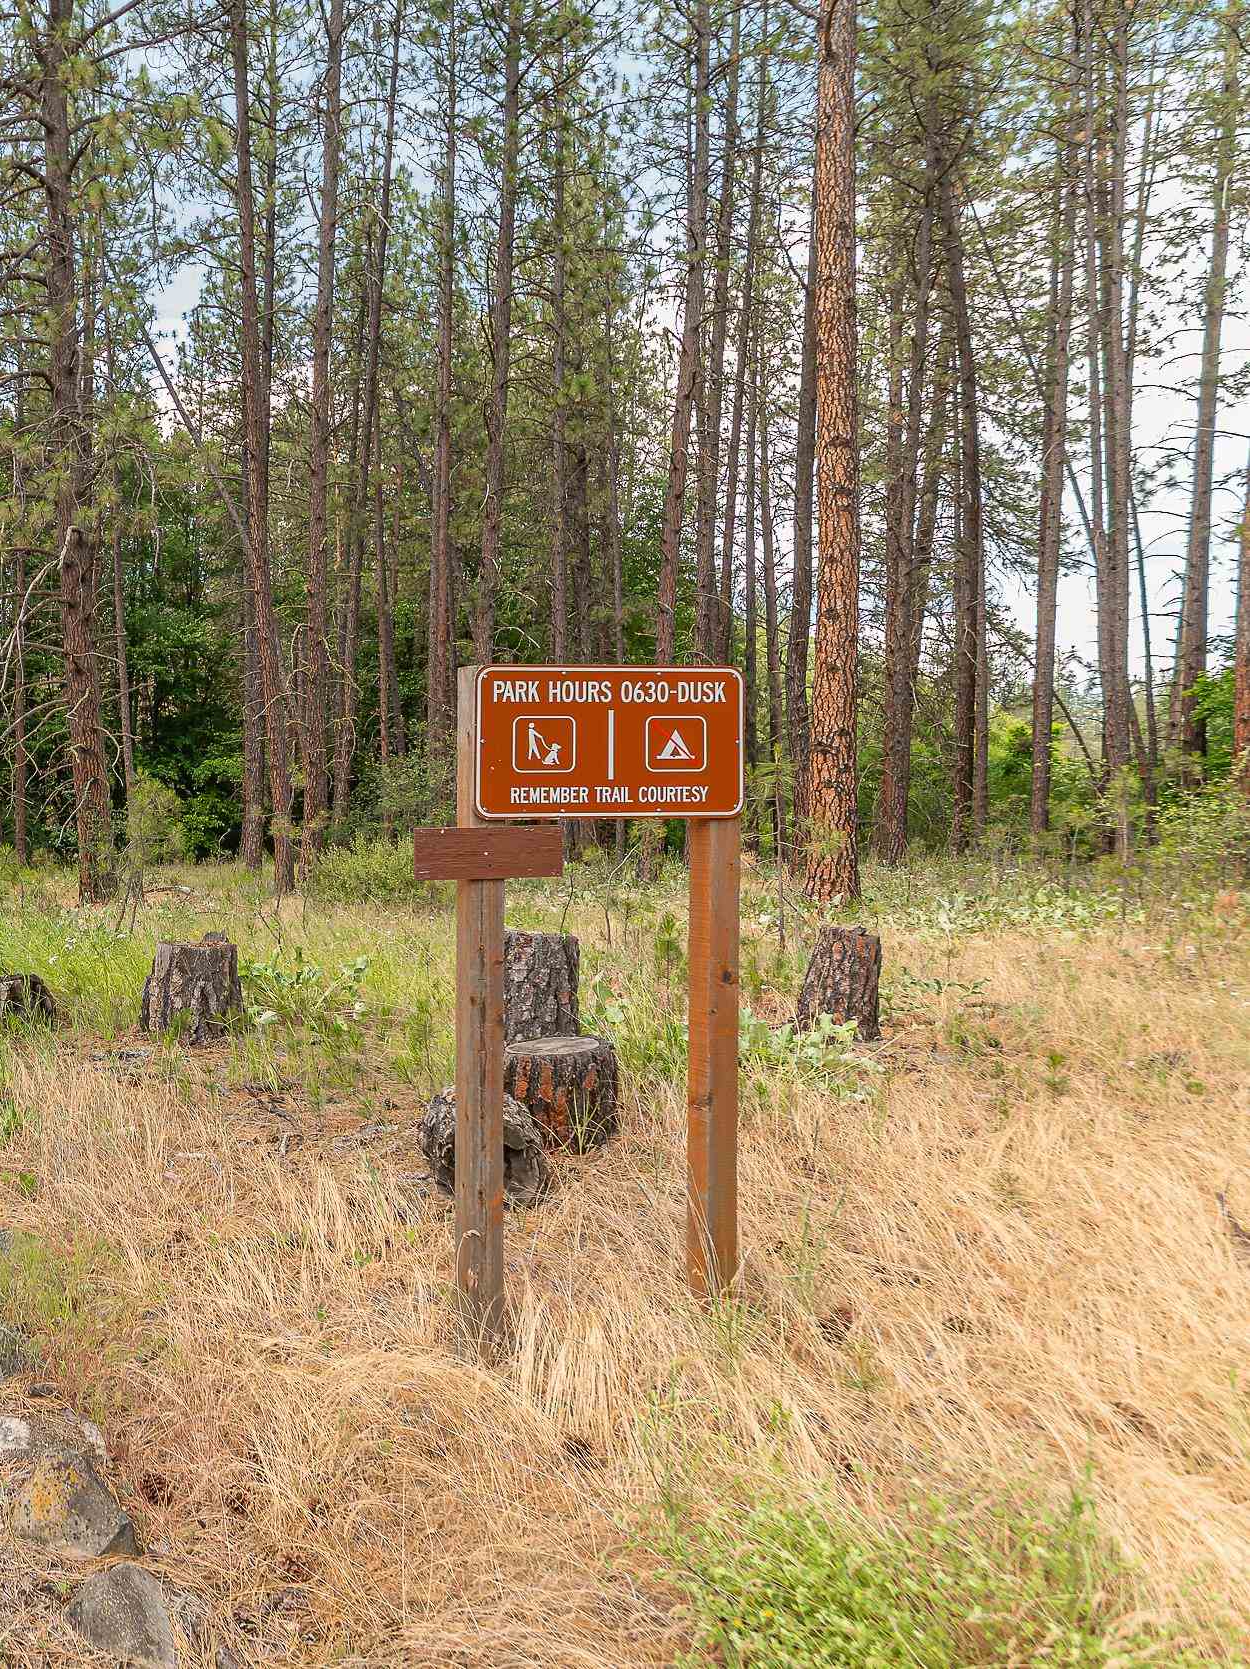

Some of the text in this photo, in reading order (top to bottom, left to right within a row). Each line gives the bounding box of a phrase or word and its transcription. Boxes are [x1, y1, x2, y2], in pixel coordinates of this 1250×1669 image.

[493, 681, 726, 703] PARK HOURS 0630-DUSK
[510, 786, 709, 804] REMEMBER TRAIL COURTESY
